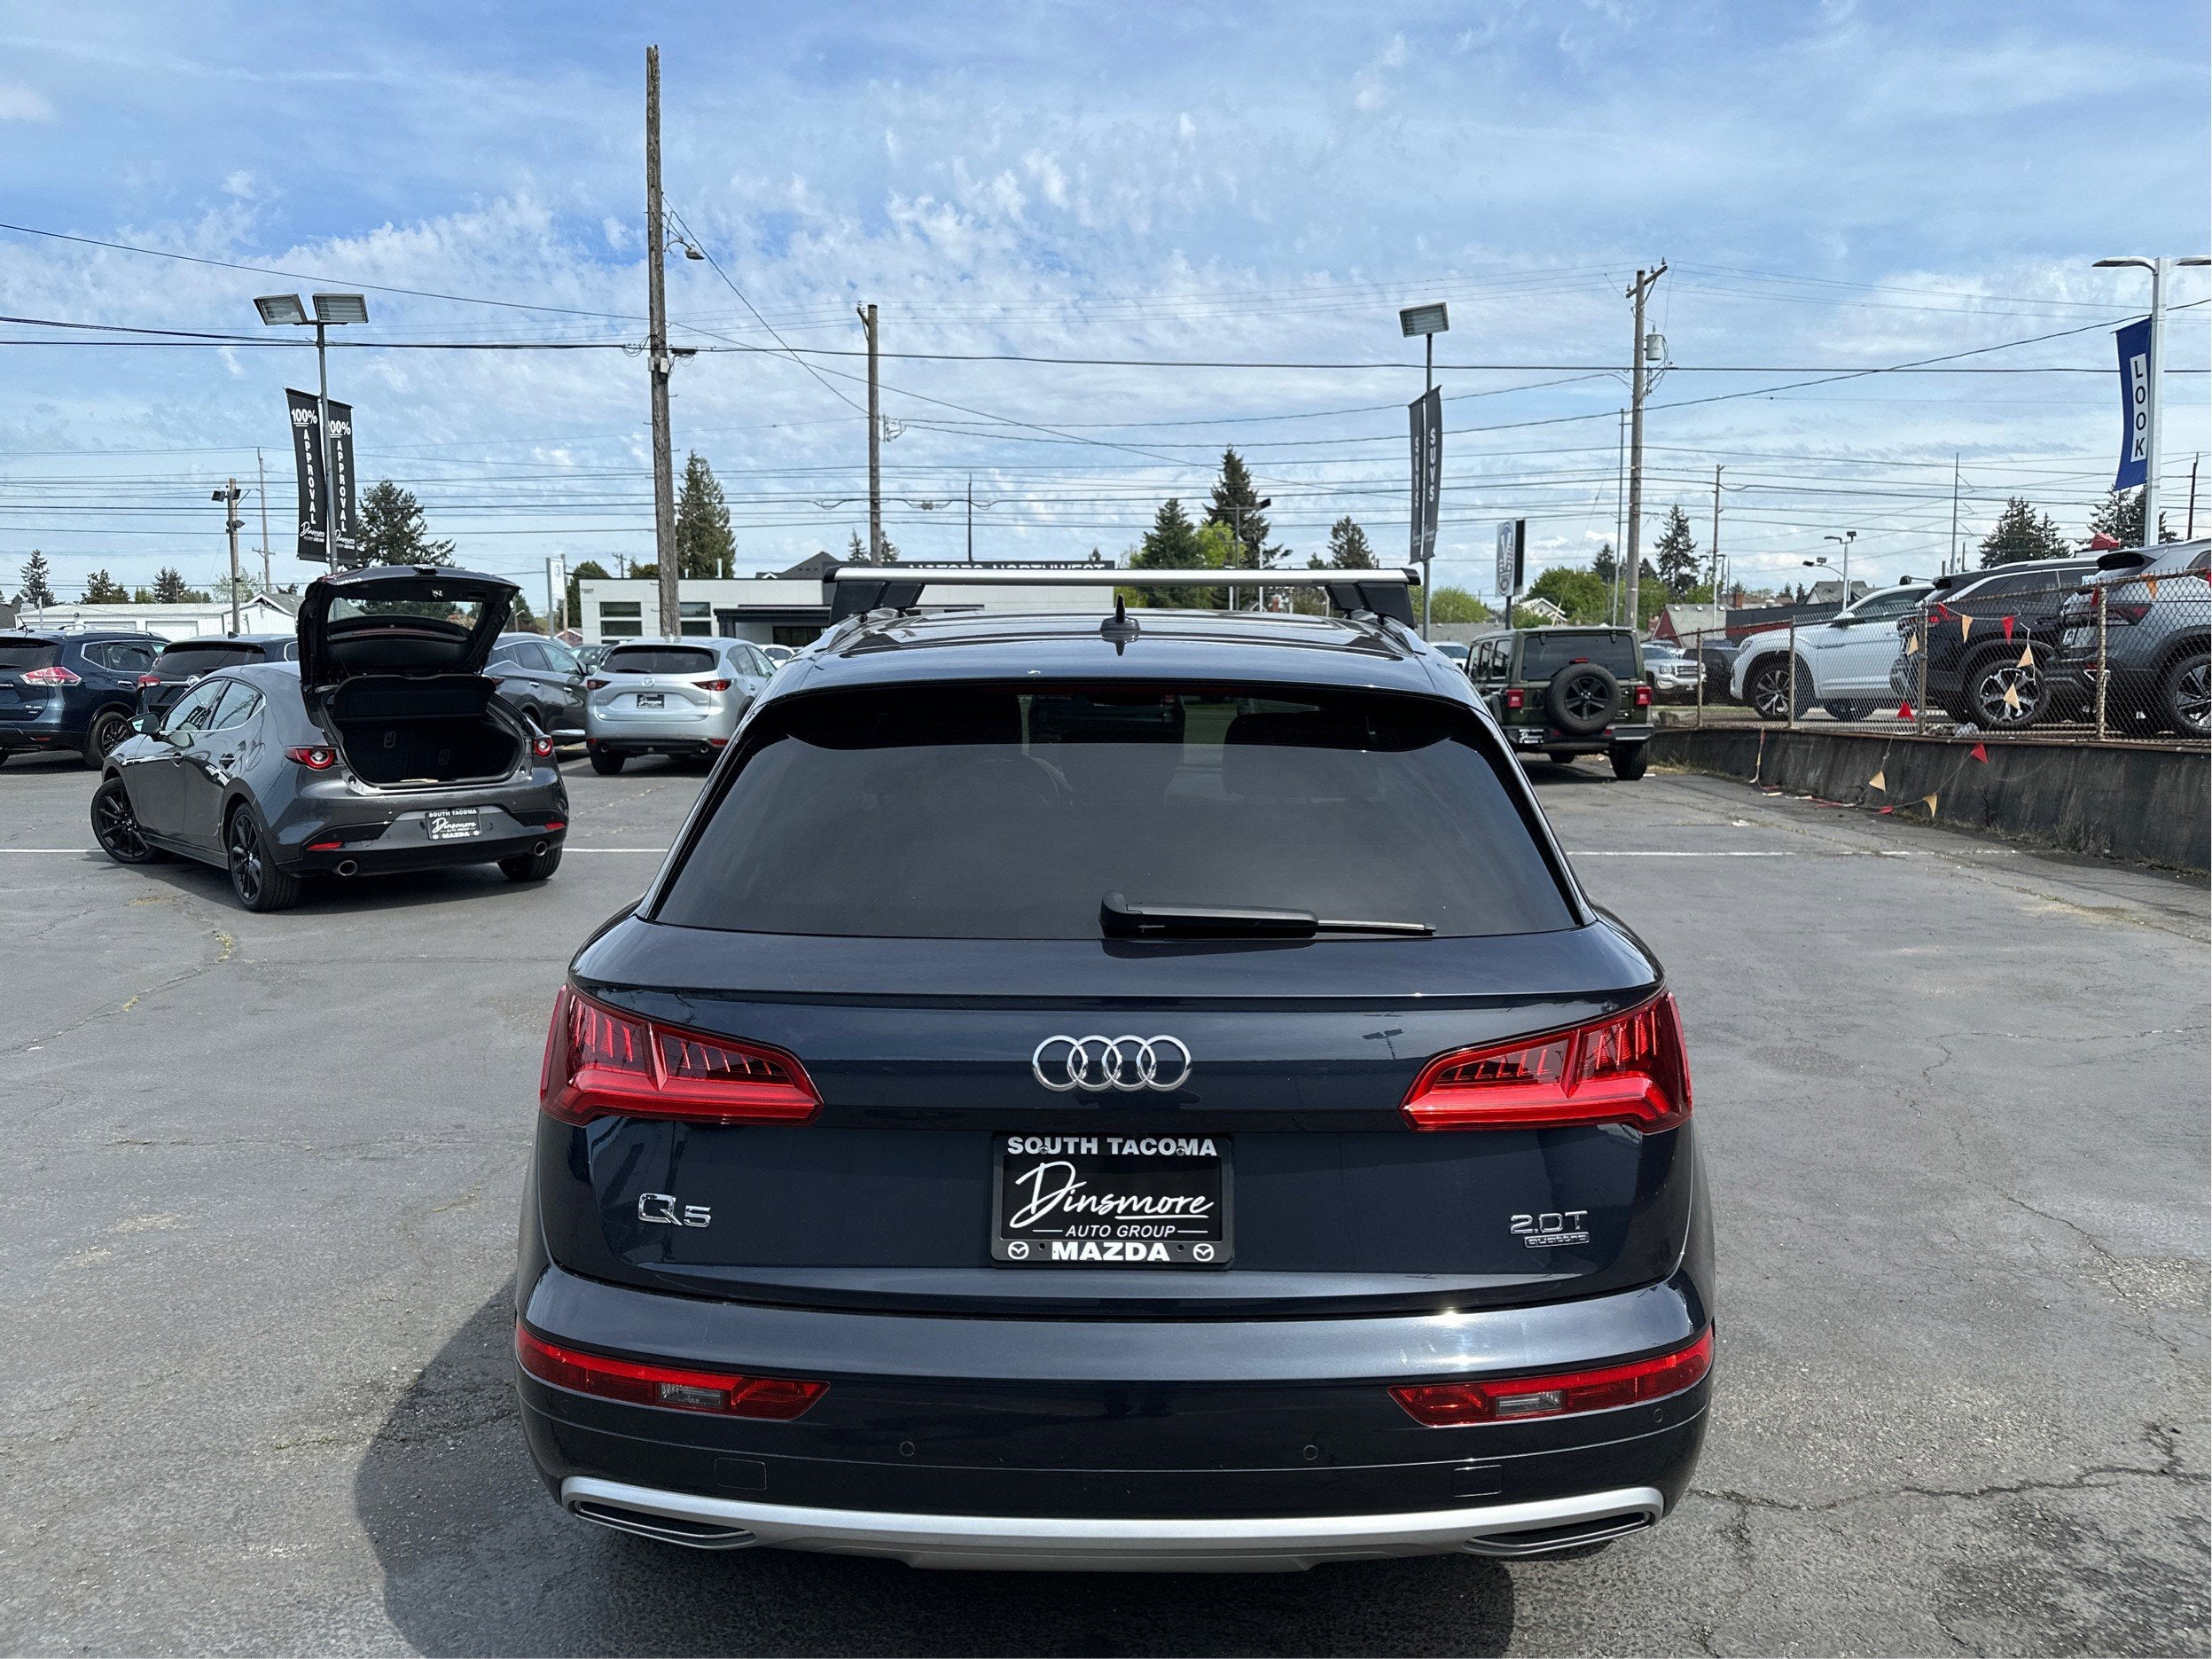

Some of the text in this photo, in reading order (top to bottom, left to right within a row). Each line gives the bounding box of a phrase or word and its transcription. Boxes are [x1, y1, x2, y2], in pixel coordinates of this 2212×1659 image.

[292, 408, 318, 425] 100%
[2134, 360, 2146, 458] LOOK
[328, 420, 351, 435] 00%
[303, 428, 317, 525] APPROVAL
[337, 440, 347, 532] APPROVAL
[1007, 1136, 1217, 1156] SOUTH TACOMA
[1009, 1161, 1215, 1229] Dinsmore
[637, 1193, 712, 1228] Q5
[1510, 1210, 1588, 1234] 2.0T
[1065, 1225, 1176, 1238] AUTO GROUP
[1051, 1241, 1170, 1262] MAZDA
